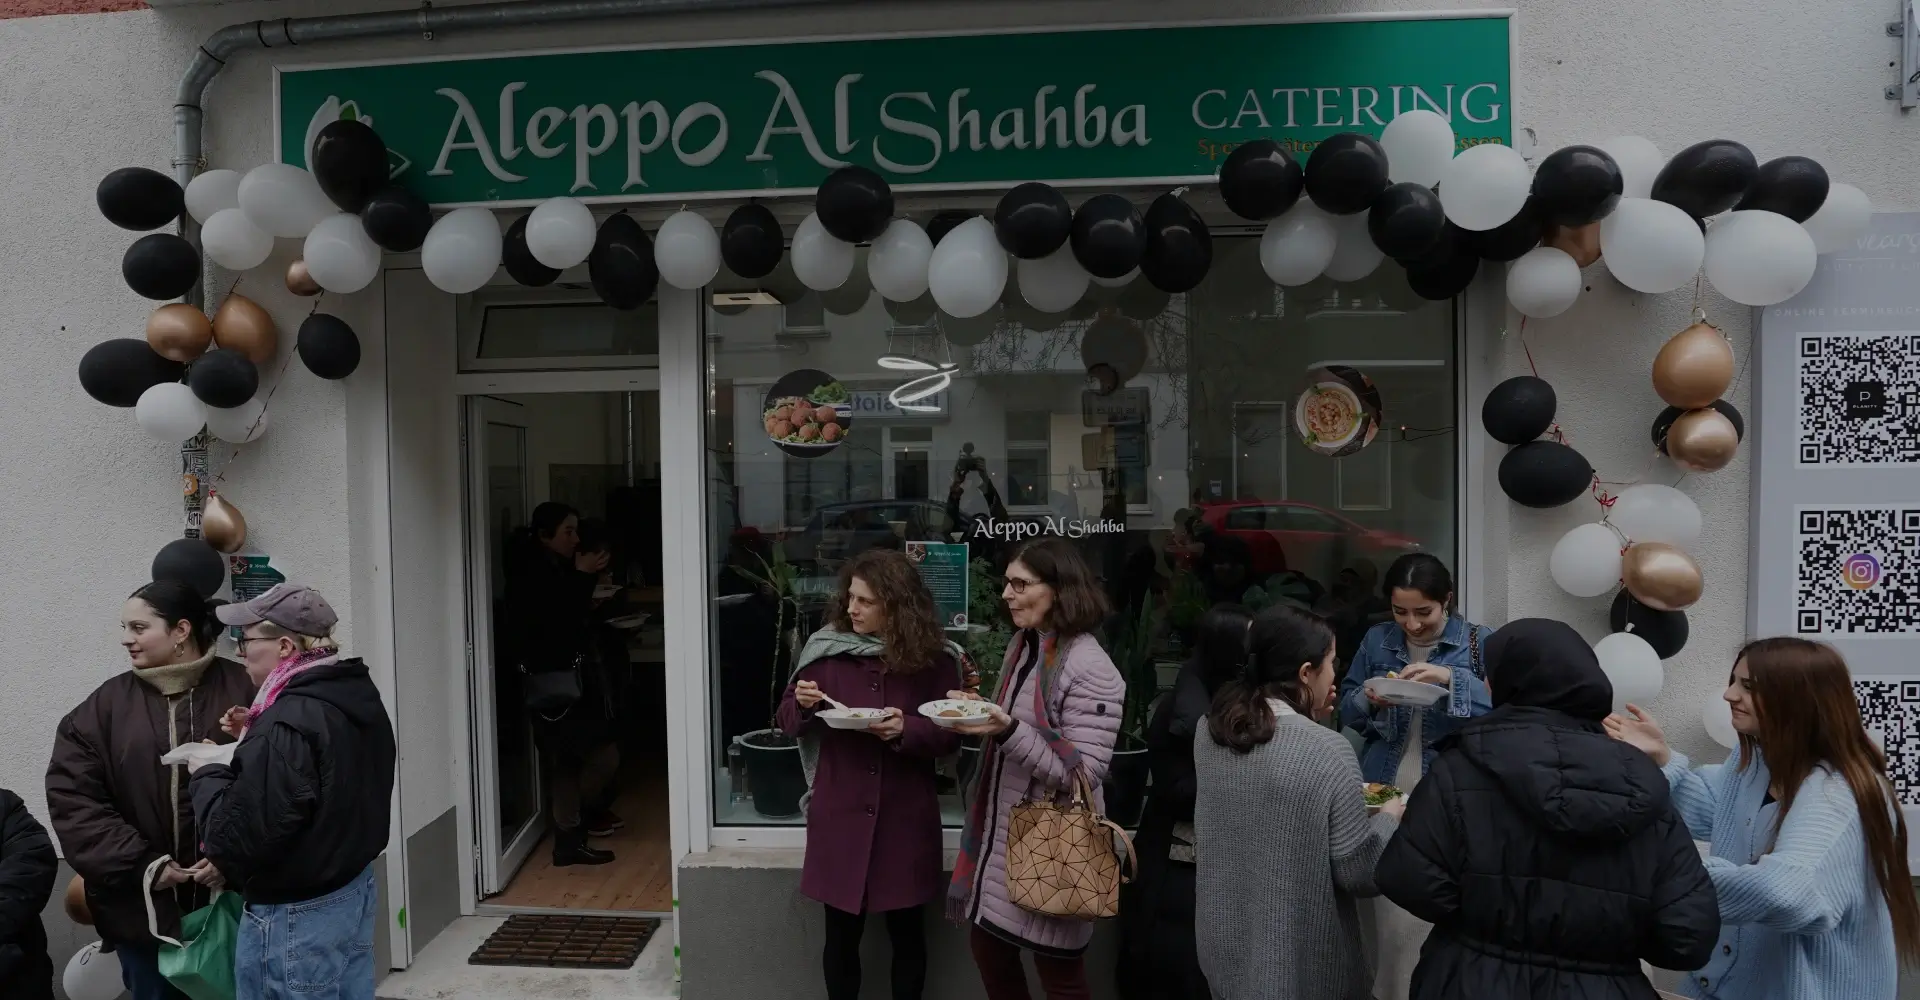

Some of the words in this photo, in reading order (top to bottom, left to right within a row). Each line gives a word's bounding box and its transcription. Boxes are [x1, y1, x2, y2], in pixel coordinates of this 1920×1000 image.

[1191, 82, 1502, 129] CATERING
[430, 81, 728, 194] Aleppo
[745, 70, 864, 169] Al
[872, 83, 1152, 174] Shahba
[1454, 132, 1503, 149] ssen
[1775, 307, 1825, 317] ONLINE
[973, 517, 1039, 541] Aleppo
[1042, 516, 1066, 536] Al
[1067, 519, 1125, 538] Shahba
